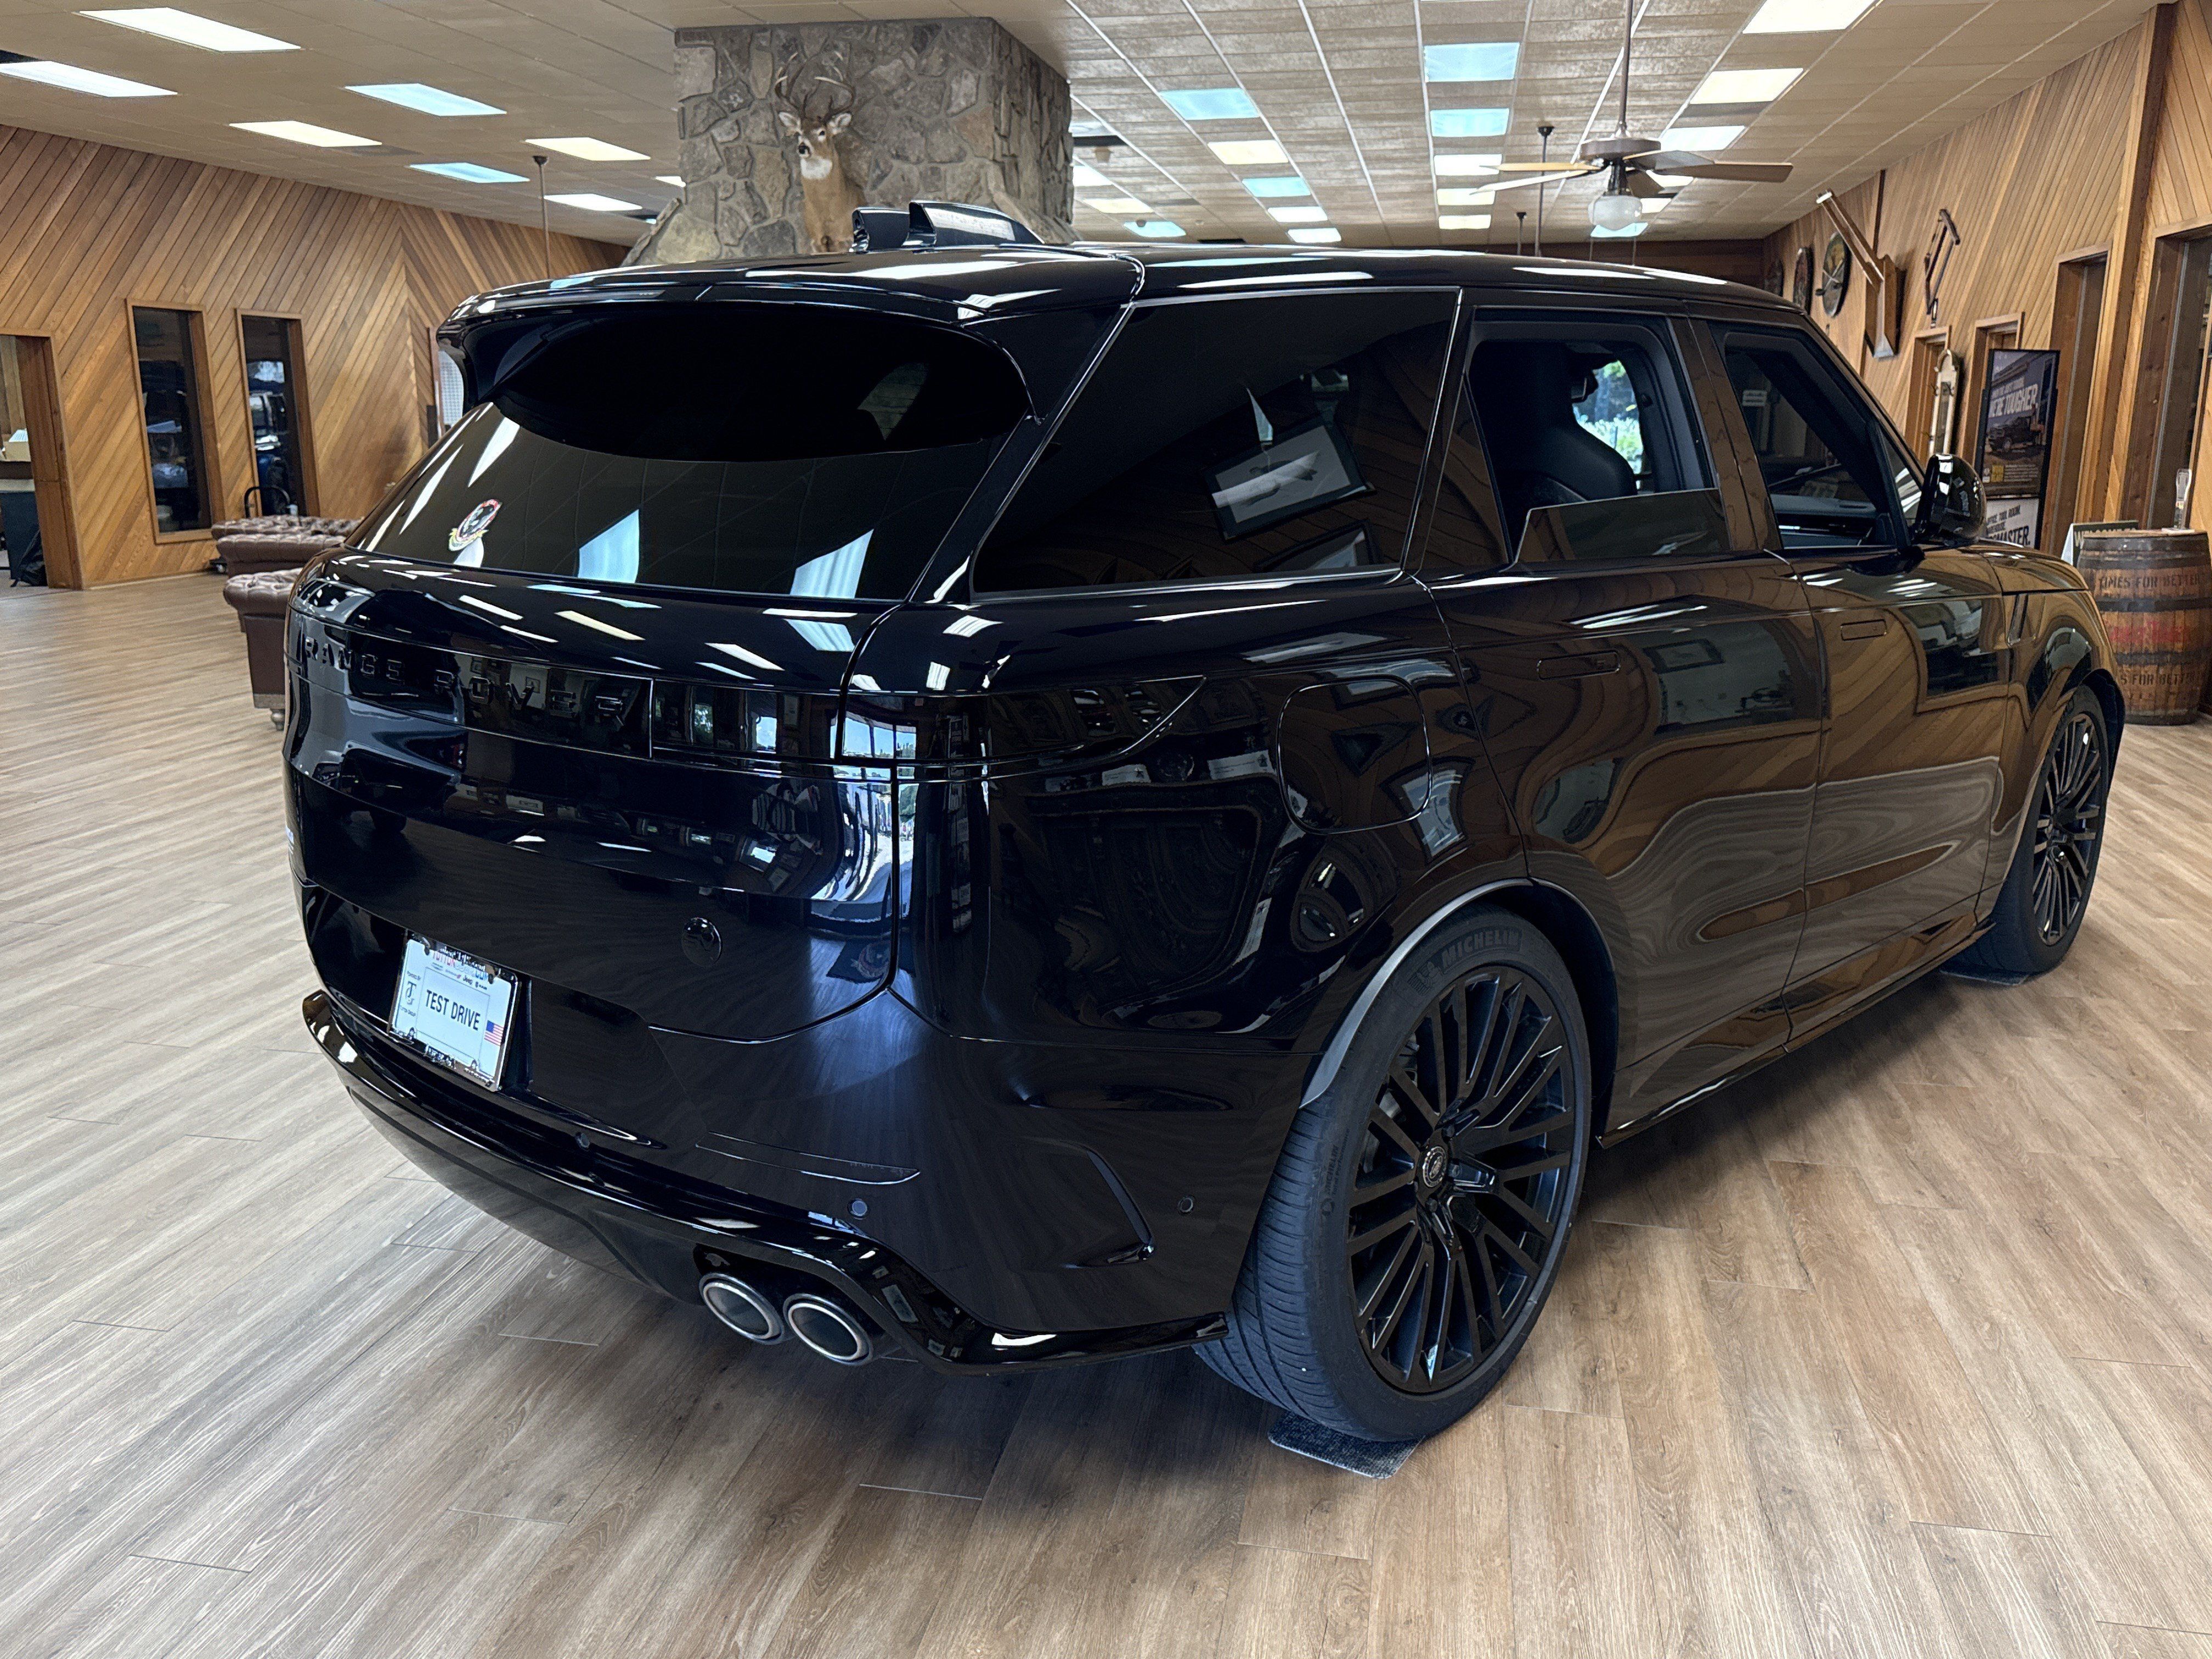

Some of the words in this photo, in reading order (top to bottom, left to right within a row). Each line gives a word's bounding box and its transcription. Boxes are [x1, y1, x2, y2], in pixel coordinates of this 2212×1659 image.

[2136, 576, 2158, 588] FOR
[435, 669, 625, 727] ROVER
[2132, 674, 2154, 686] FOR
[1442, 929, 1520, 970] MICHELIN
[425, 989, 450, 1015] TEST
[451, 1002, 481, 1031] DRIVE
[1325, 1145, 1339, 1195] MICHELIN
